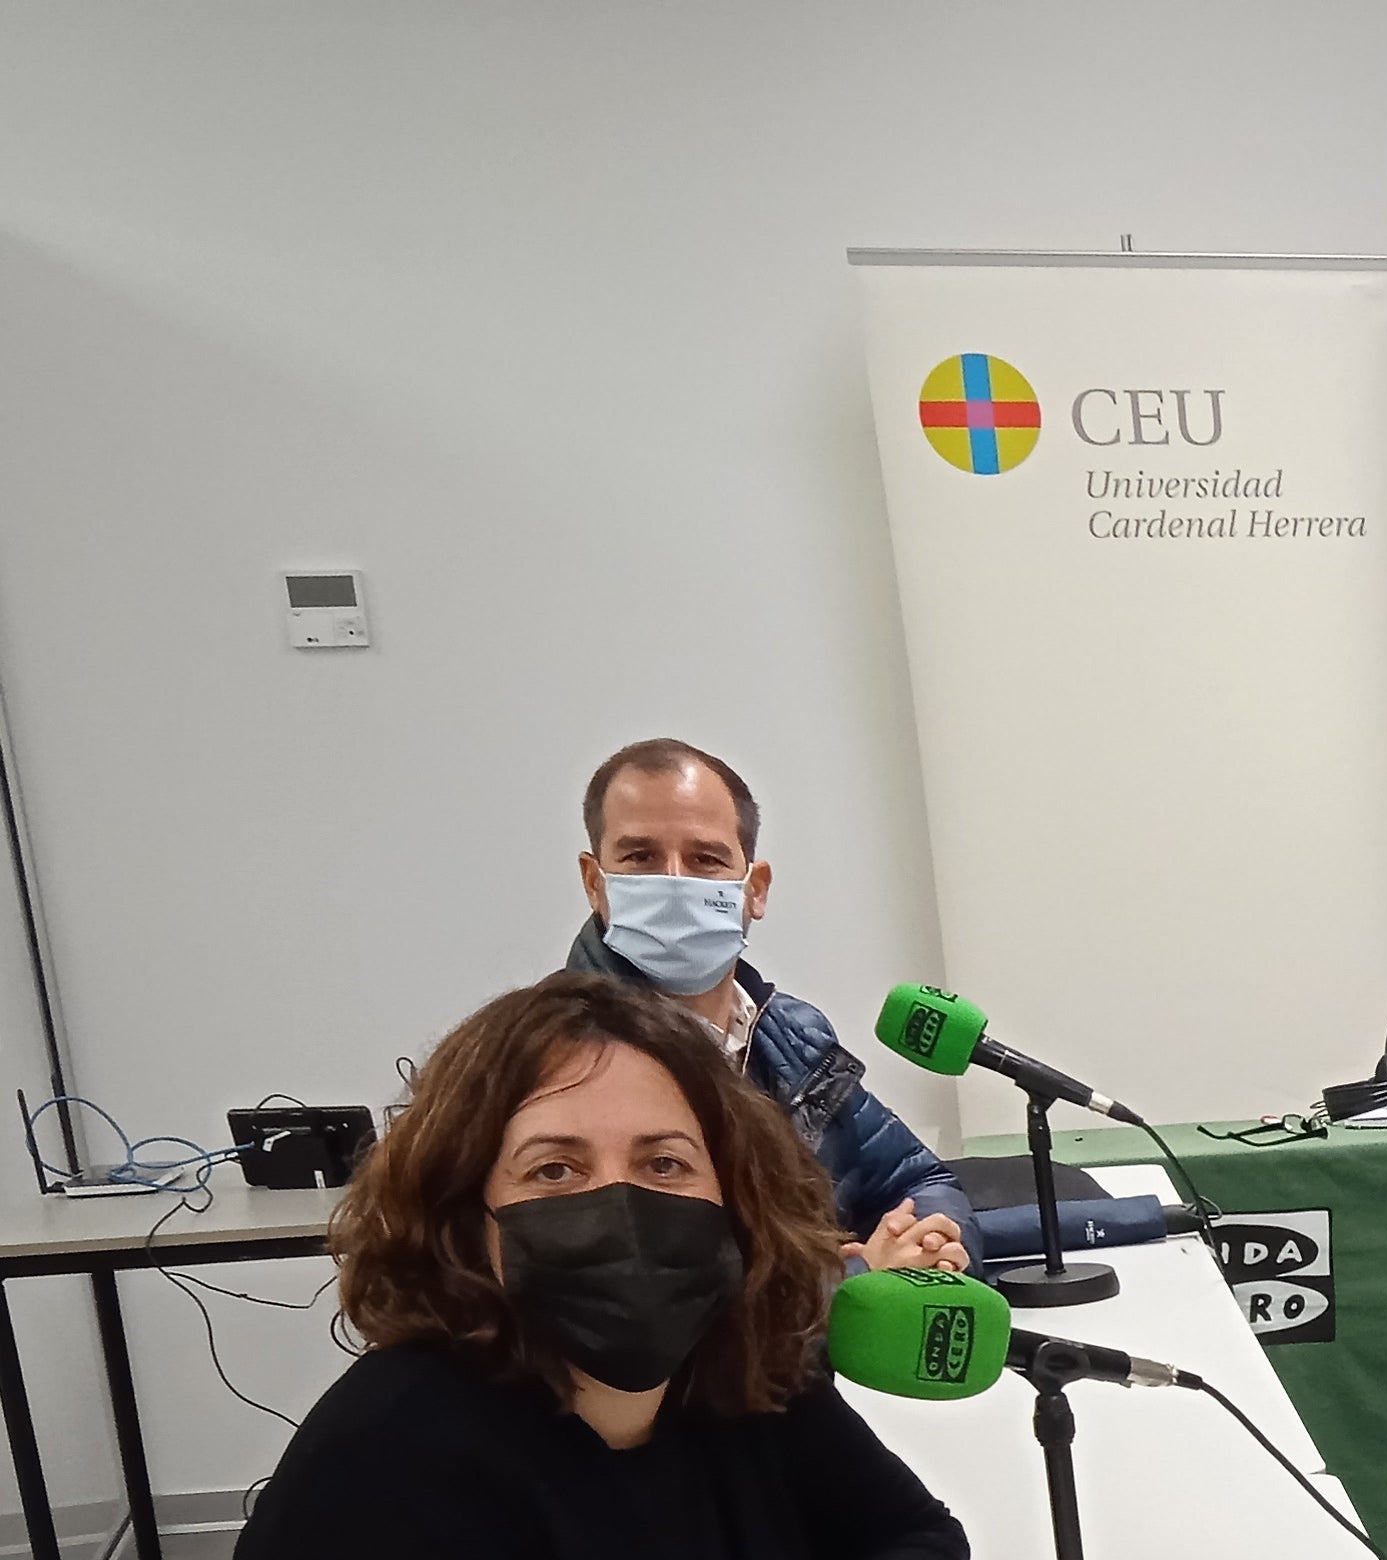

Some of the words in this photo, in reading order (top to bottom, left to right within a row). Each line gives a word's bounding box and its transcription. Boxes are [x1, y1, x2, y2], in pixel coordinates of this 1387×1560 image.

[1071, 387, 1226, 447] CEU
[1086, 469, 1284, 499] Universidad
[1088, 509, 1238, 539] Cardenal
[1247, 511, 1368, 538] Herrera
[1221, 1240, 1303, 1265] DA
[1249, 1293, 1305, 1323] RO
[928, 1318, 946, 1372] ONDA
[948, 1317, 967, 1370] CERO
